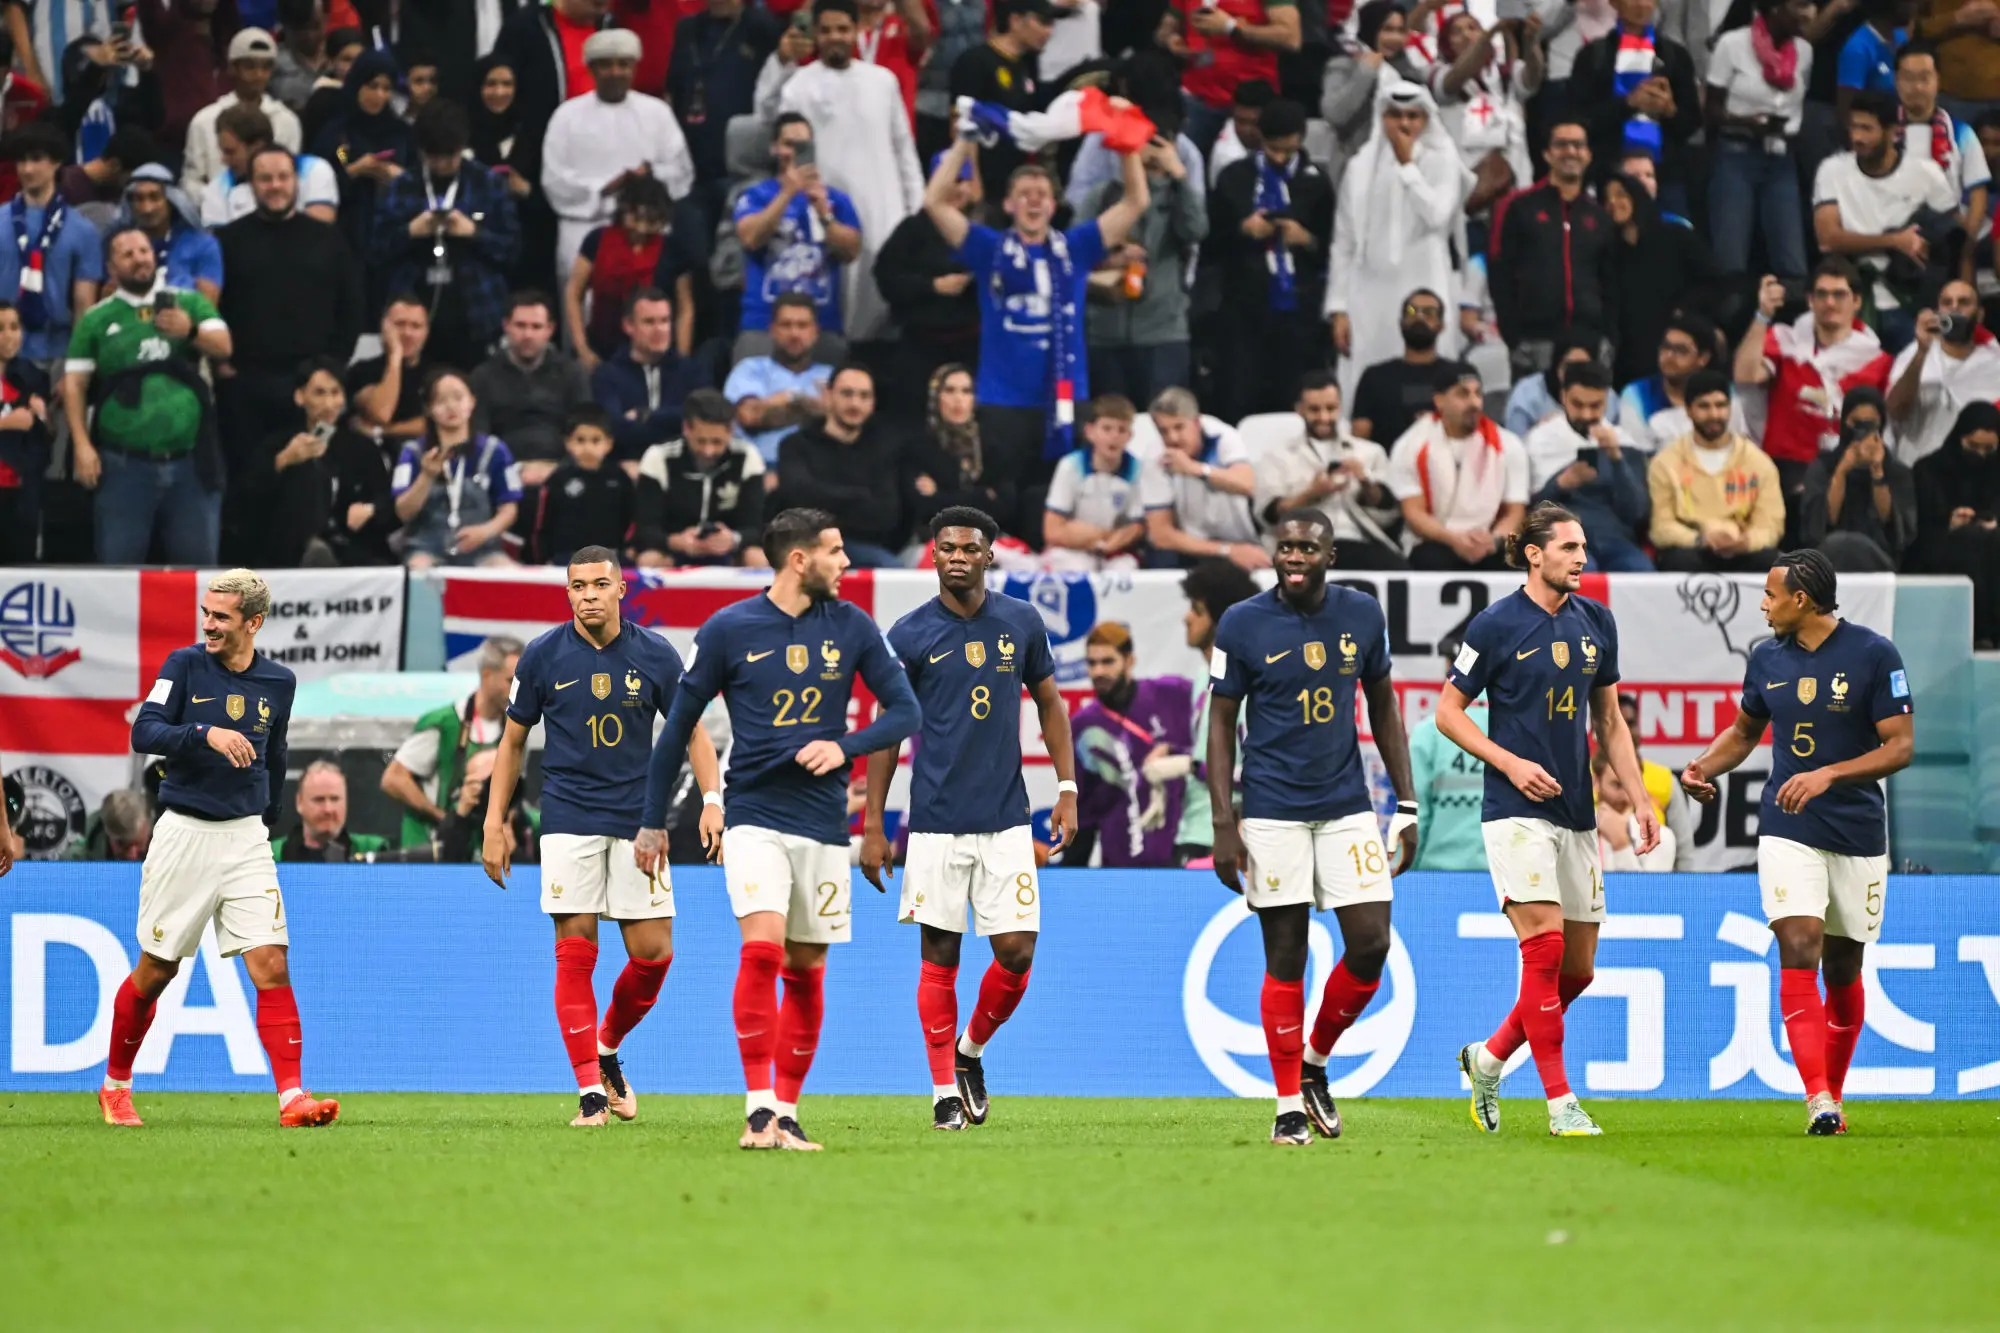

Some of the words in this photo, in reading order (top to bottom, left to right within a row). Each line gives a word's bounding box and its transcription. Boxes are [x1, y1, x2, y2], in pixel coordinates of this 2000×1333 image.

[325, 599, 373, 616] MRS
[378, 597, 393, 613] P
[293, 624, 310, 641] &
[323, 642, 381, 661] JOHN
[772, 686, 822, 727] 22
[970, 685, 992, 720] 8
[1297, 686, 1335, 725] 18
[1545, 686, 1577, 721] 14
[586, 713, 623, 748] 10
[1790, 722, 1815, 757] 5
[1347, 840, 1384, 876] 18
[265, 888, 281, 920] 7
[1015, 872, 1035, 906] 8
[1865, 880, 1881, 916] 5
